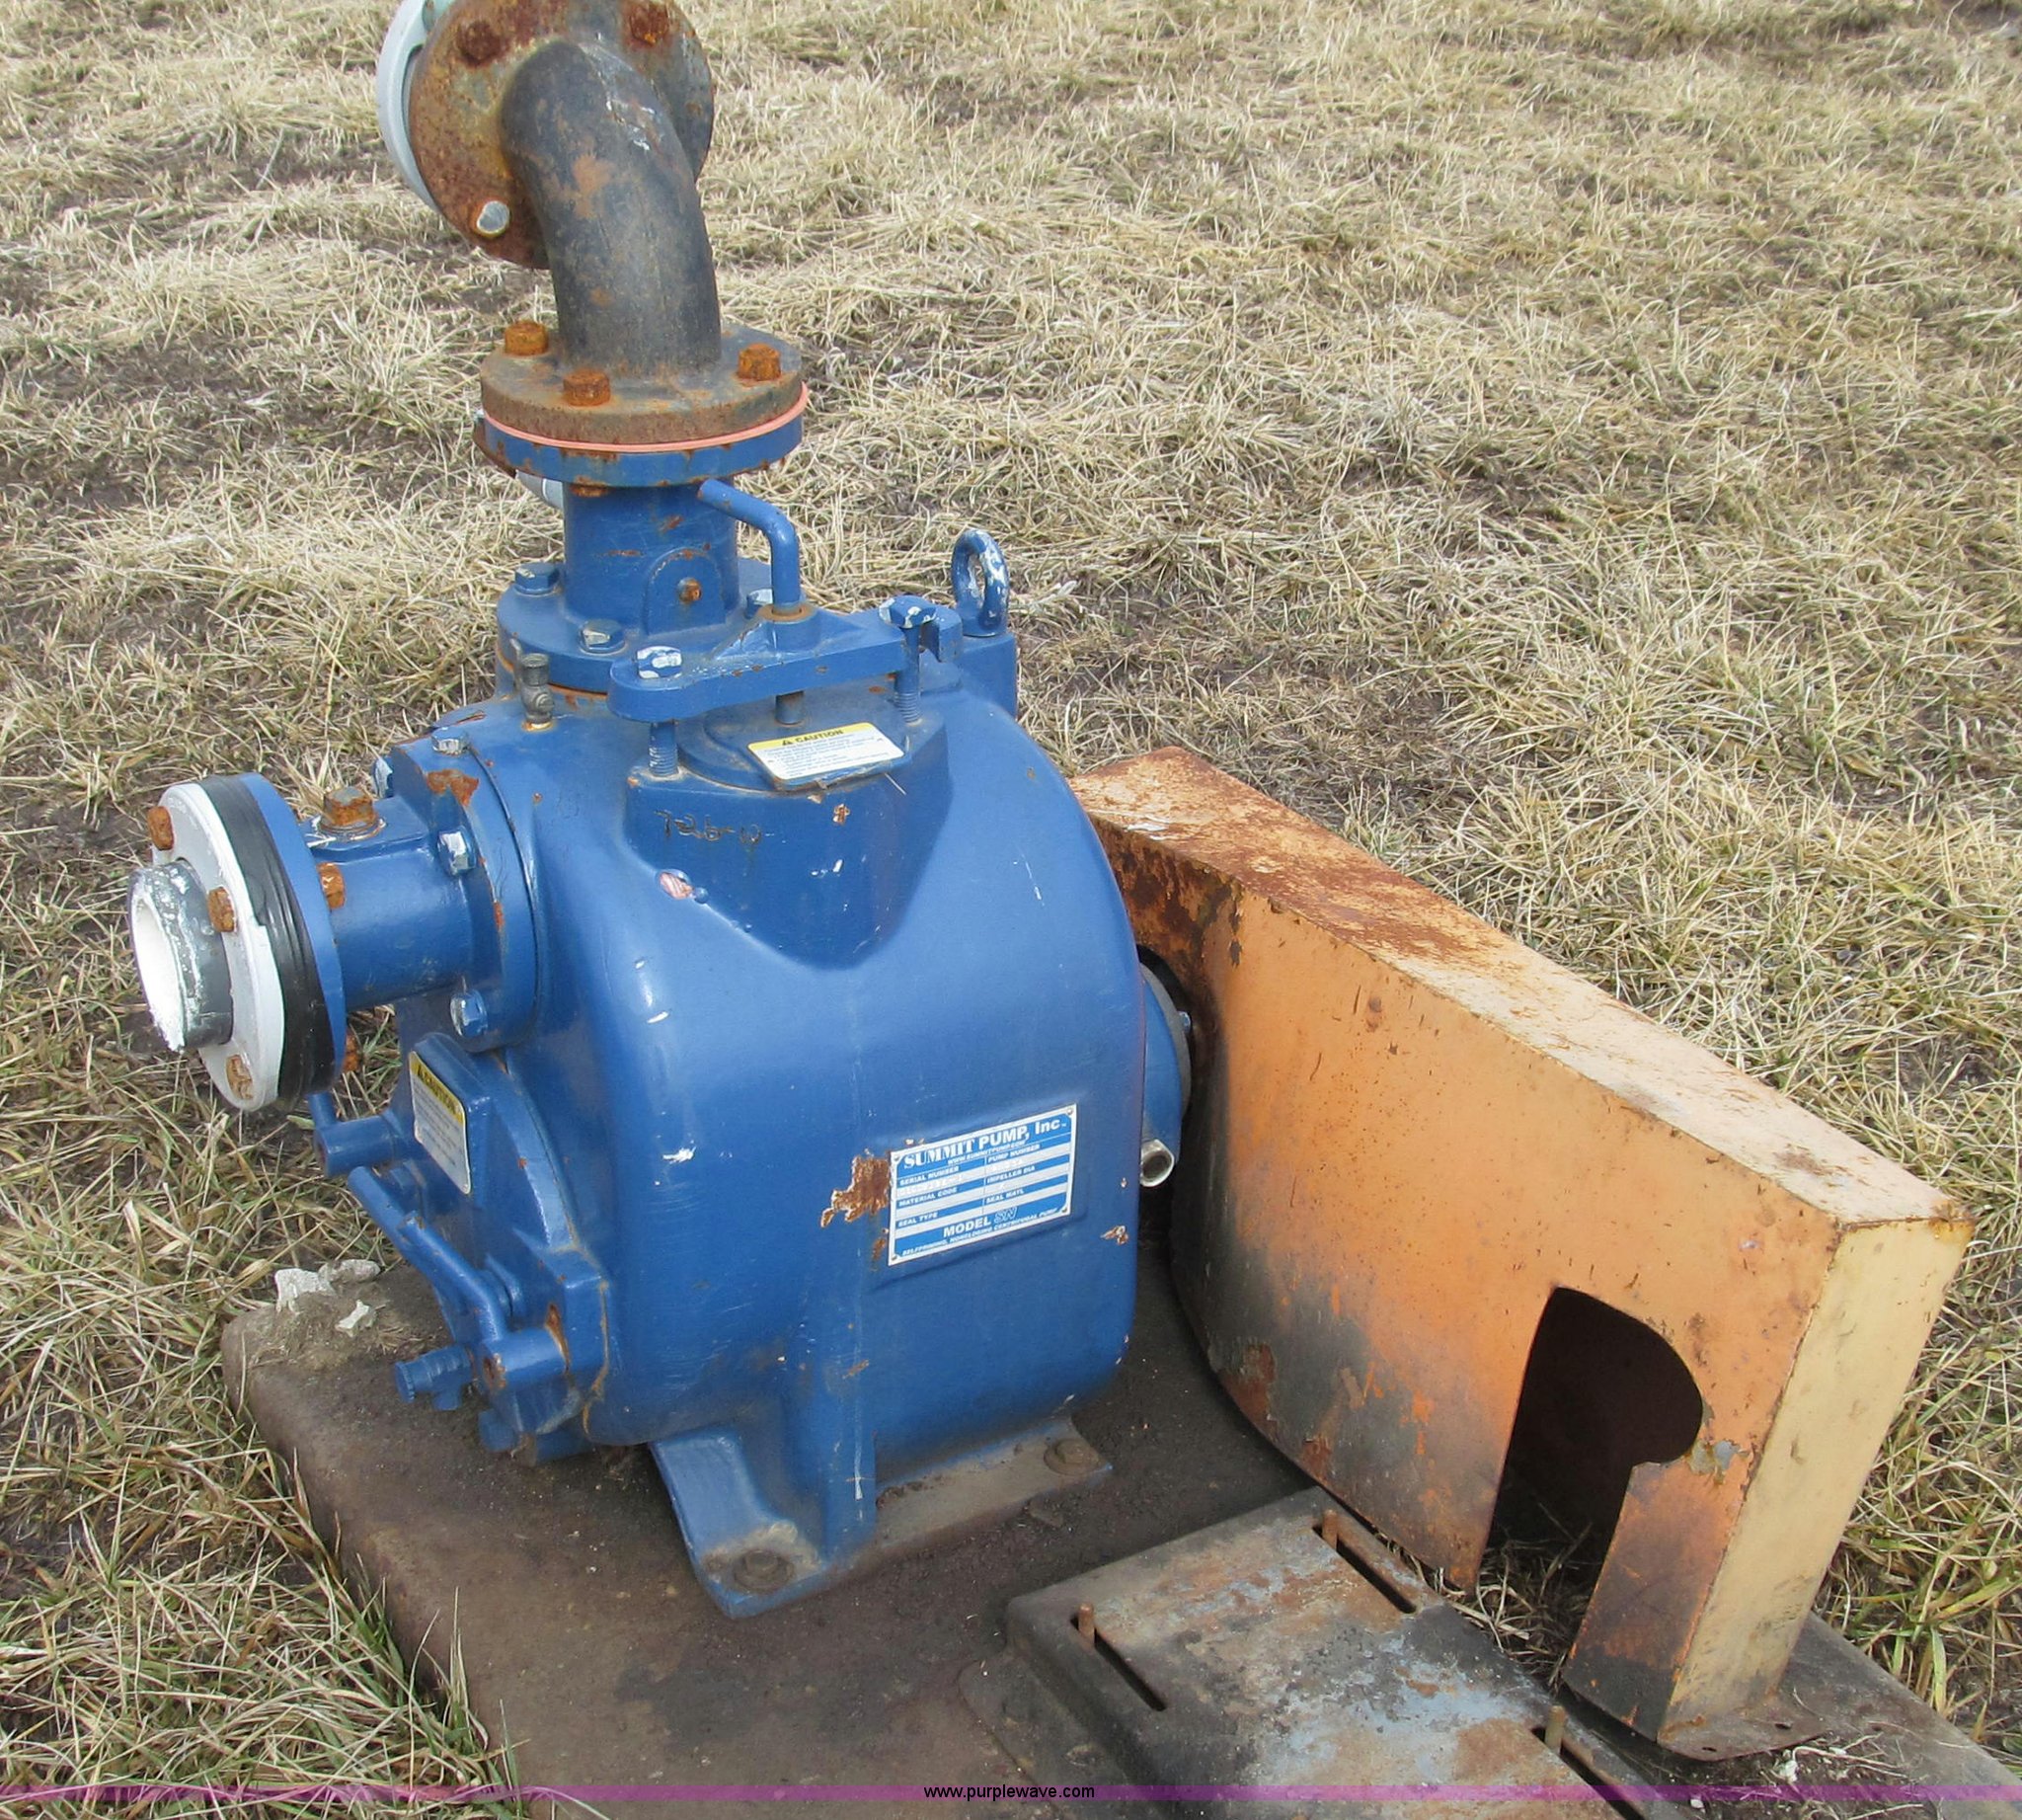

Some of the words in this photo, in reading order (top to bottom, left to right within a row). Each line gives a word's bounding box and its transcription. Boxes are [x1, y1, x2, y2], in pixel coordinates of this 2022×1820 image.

[795, 729, 844, 743] CAUTION
[903, 1138, 975, 1169] SUMMIT
[978, 1126, 1030, 1150] PUMP,
[988, 1152, 1008, 1163] PUMP
[1010, 1144, 1040, 1157] NUMBER
[899, 1174, 926, 1186] SERIAL
[928, 1165, 960, 1179] NUMBER
[987, 1168, 1022, 1184] IMPELLER
[898, 1193, 935, 1207] MATERIAL
[937, 1186, 958, 1198] CODE
[898, 1218, 917, 1227] SEAL
[918, 1211, 938, 1223] TYPE
[943, 1216, 992, 1237] MODEL
